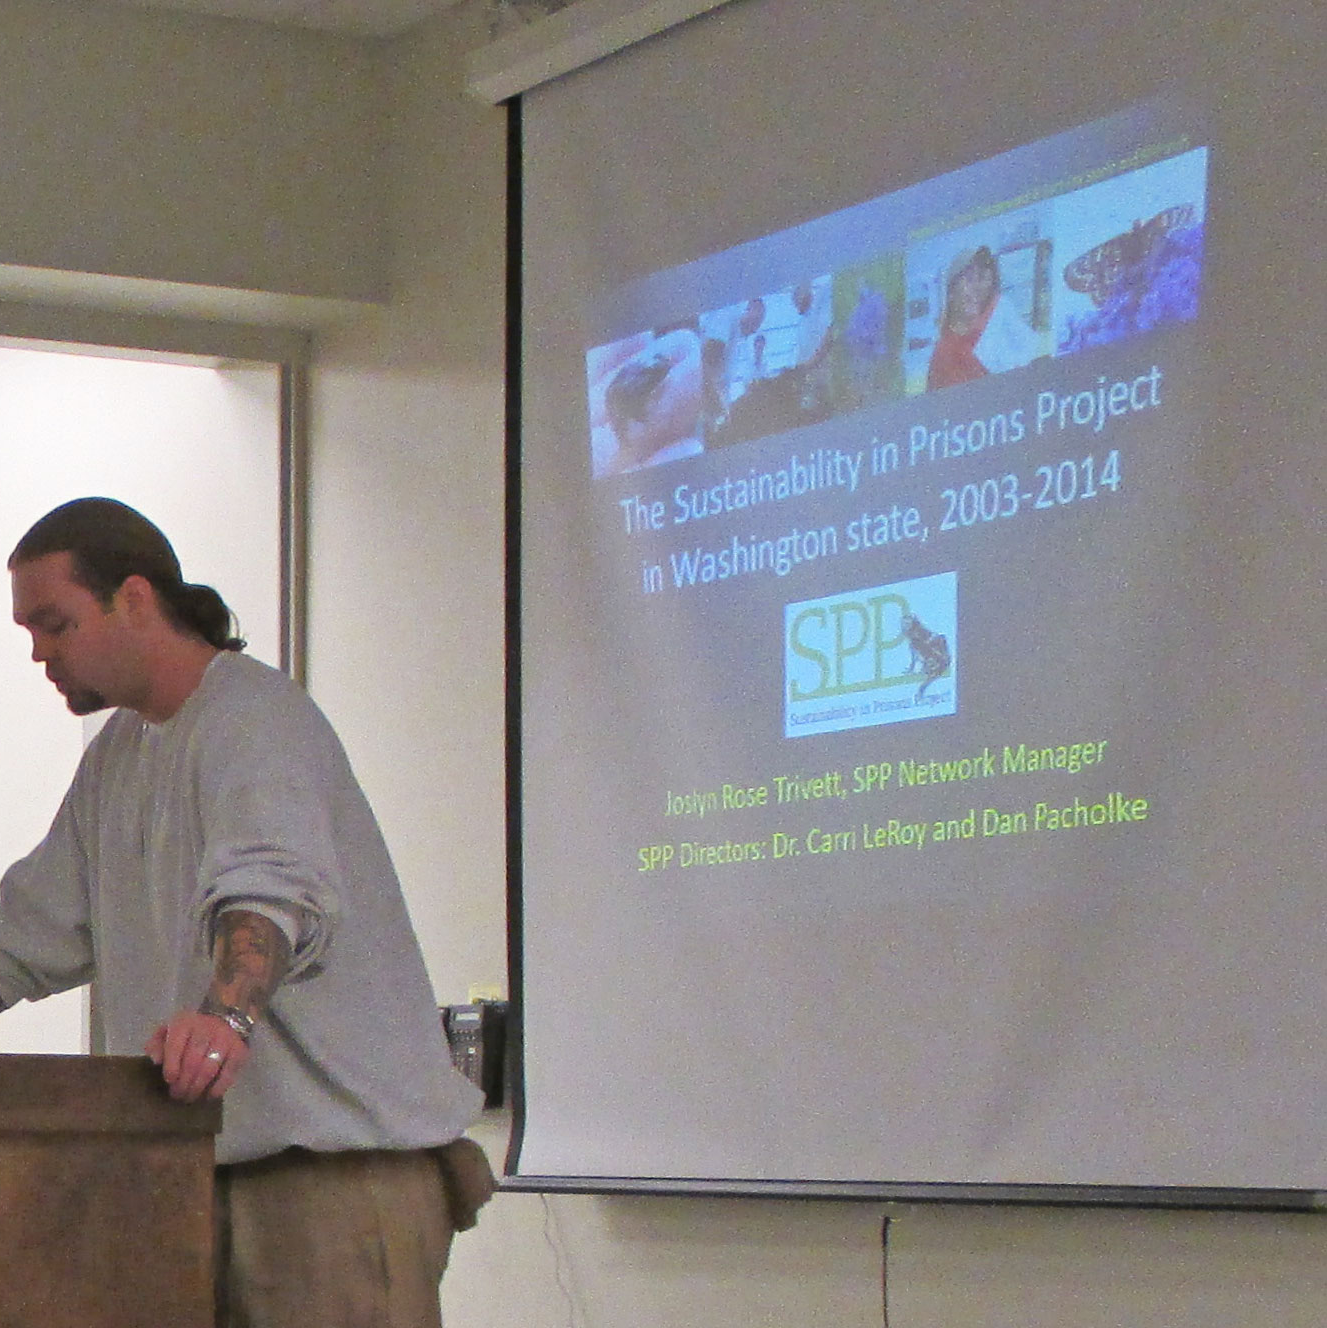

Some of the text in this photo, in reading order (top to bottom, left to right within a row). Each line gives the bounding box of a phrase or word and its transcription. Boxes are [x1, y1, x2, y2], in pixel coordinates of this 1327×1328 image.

[619, 365, 1165, 535] The Sustainability in Prisons Project
[643, 449, 1122, 593] in Washington state, 2003-2014
[789, 593, 911, 702] SPP
[638, 792, 1150, 871] SPP Directors: Dr. Carri LeRoy and Dan Pacholke
[665, 740, 1108, 818] Joslyn Rose Trivett, SPP Network Manager
